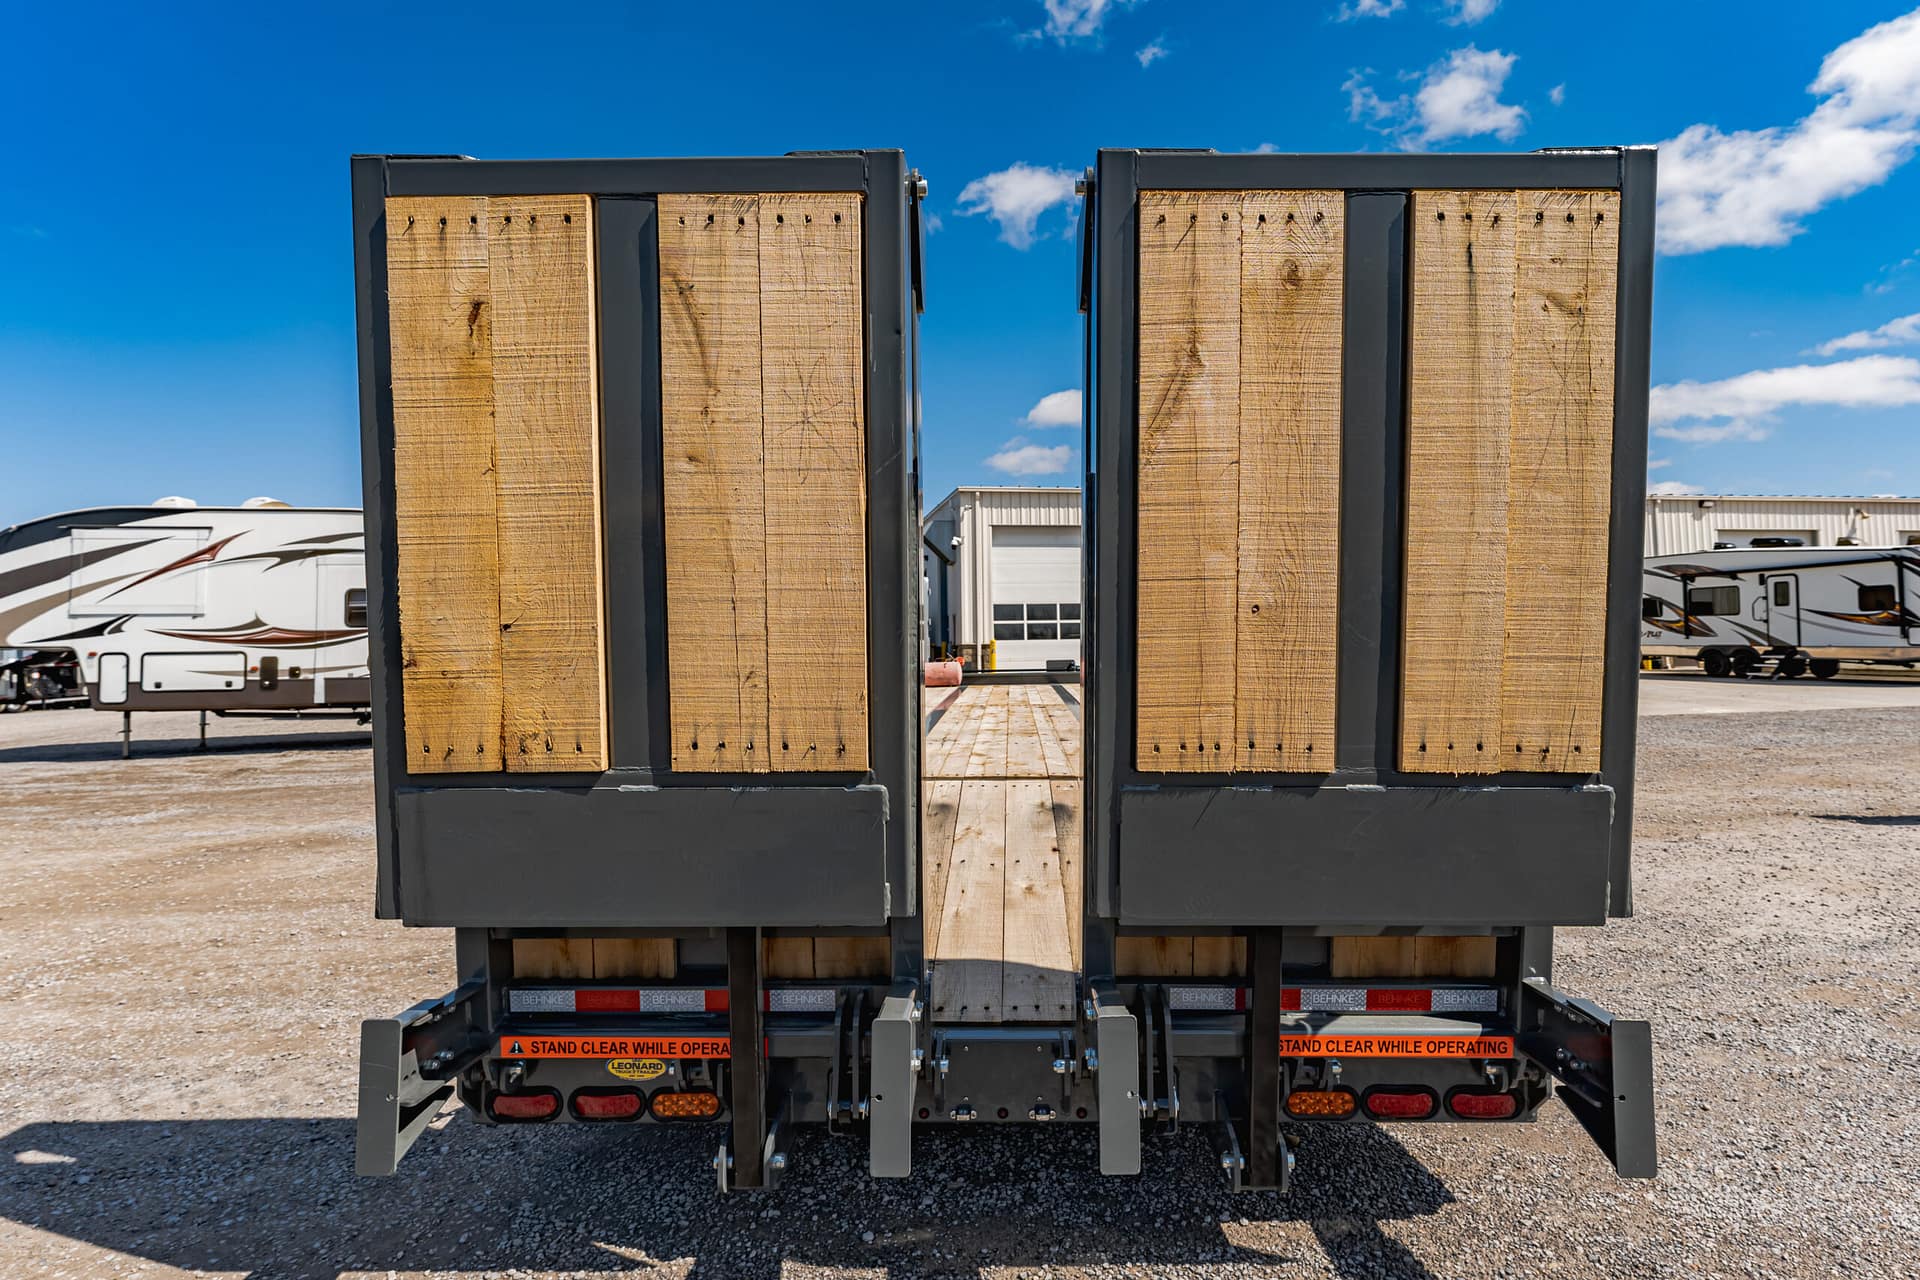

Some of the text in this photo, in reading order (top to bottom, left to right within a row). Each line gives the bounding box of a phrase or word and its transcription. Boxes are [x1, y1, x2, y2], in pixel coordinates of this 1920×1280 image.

[522, 995, 564, 1005] BEHNKE
[652, 995, 694, 1005] BEHNKE
[782, 994, 824, 1004] BEHNKE
[1182, 993, 1224, 1002] BEHNKE
[1313, 994, 1355, 1003] BEHNKE
[1444, 994, 1486, 1004] BEHNKE
[531, 1041, 730, 1055] STAND CLEAR WHILE OPERA
[1326, 1040, 1373, 1053] CLEAR
[1377, 1040, 1422, 1054] WHILE
[1426, 1040, 1508, 1054] OPERATING
[612, 1062, 663, 1070] LEONARD
